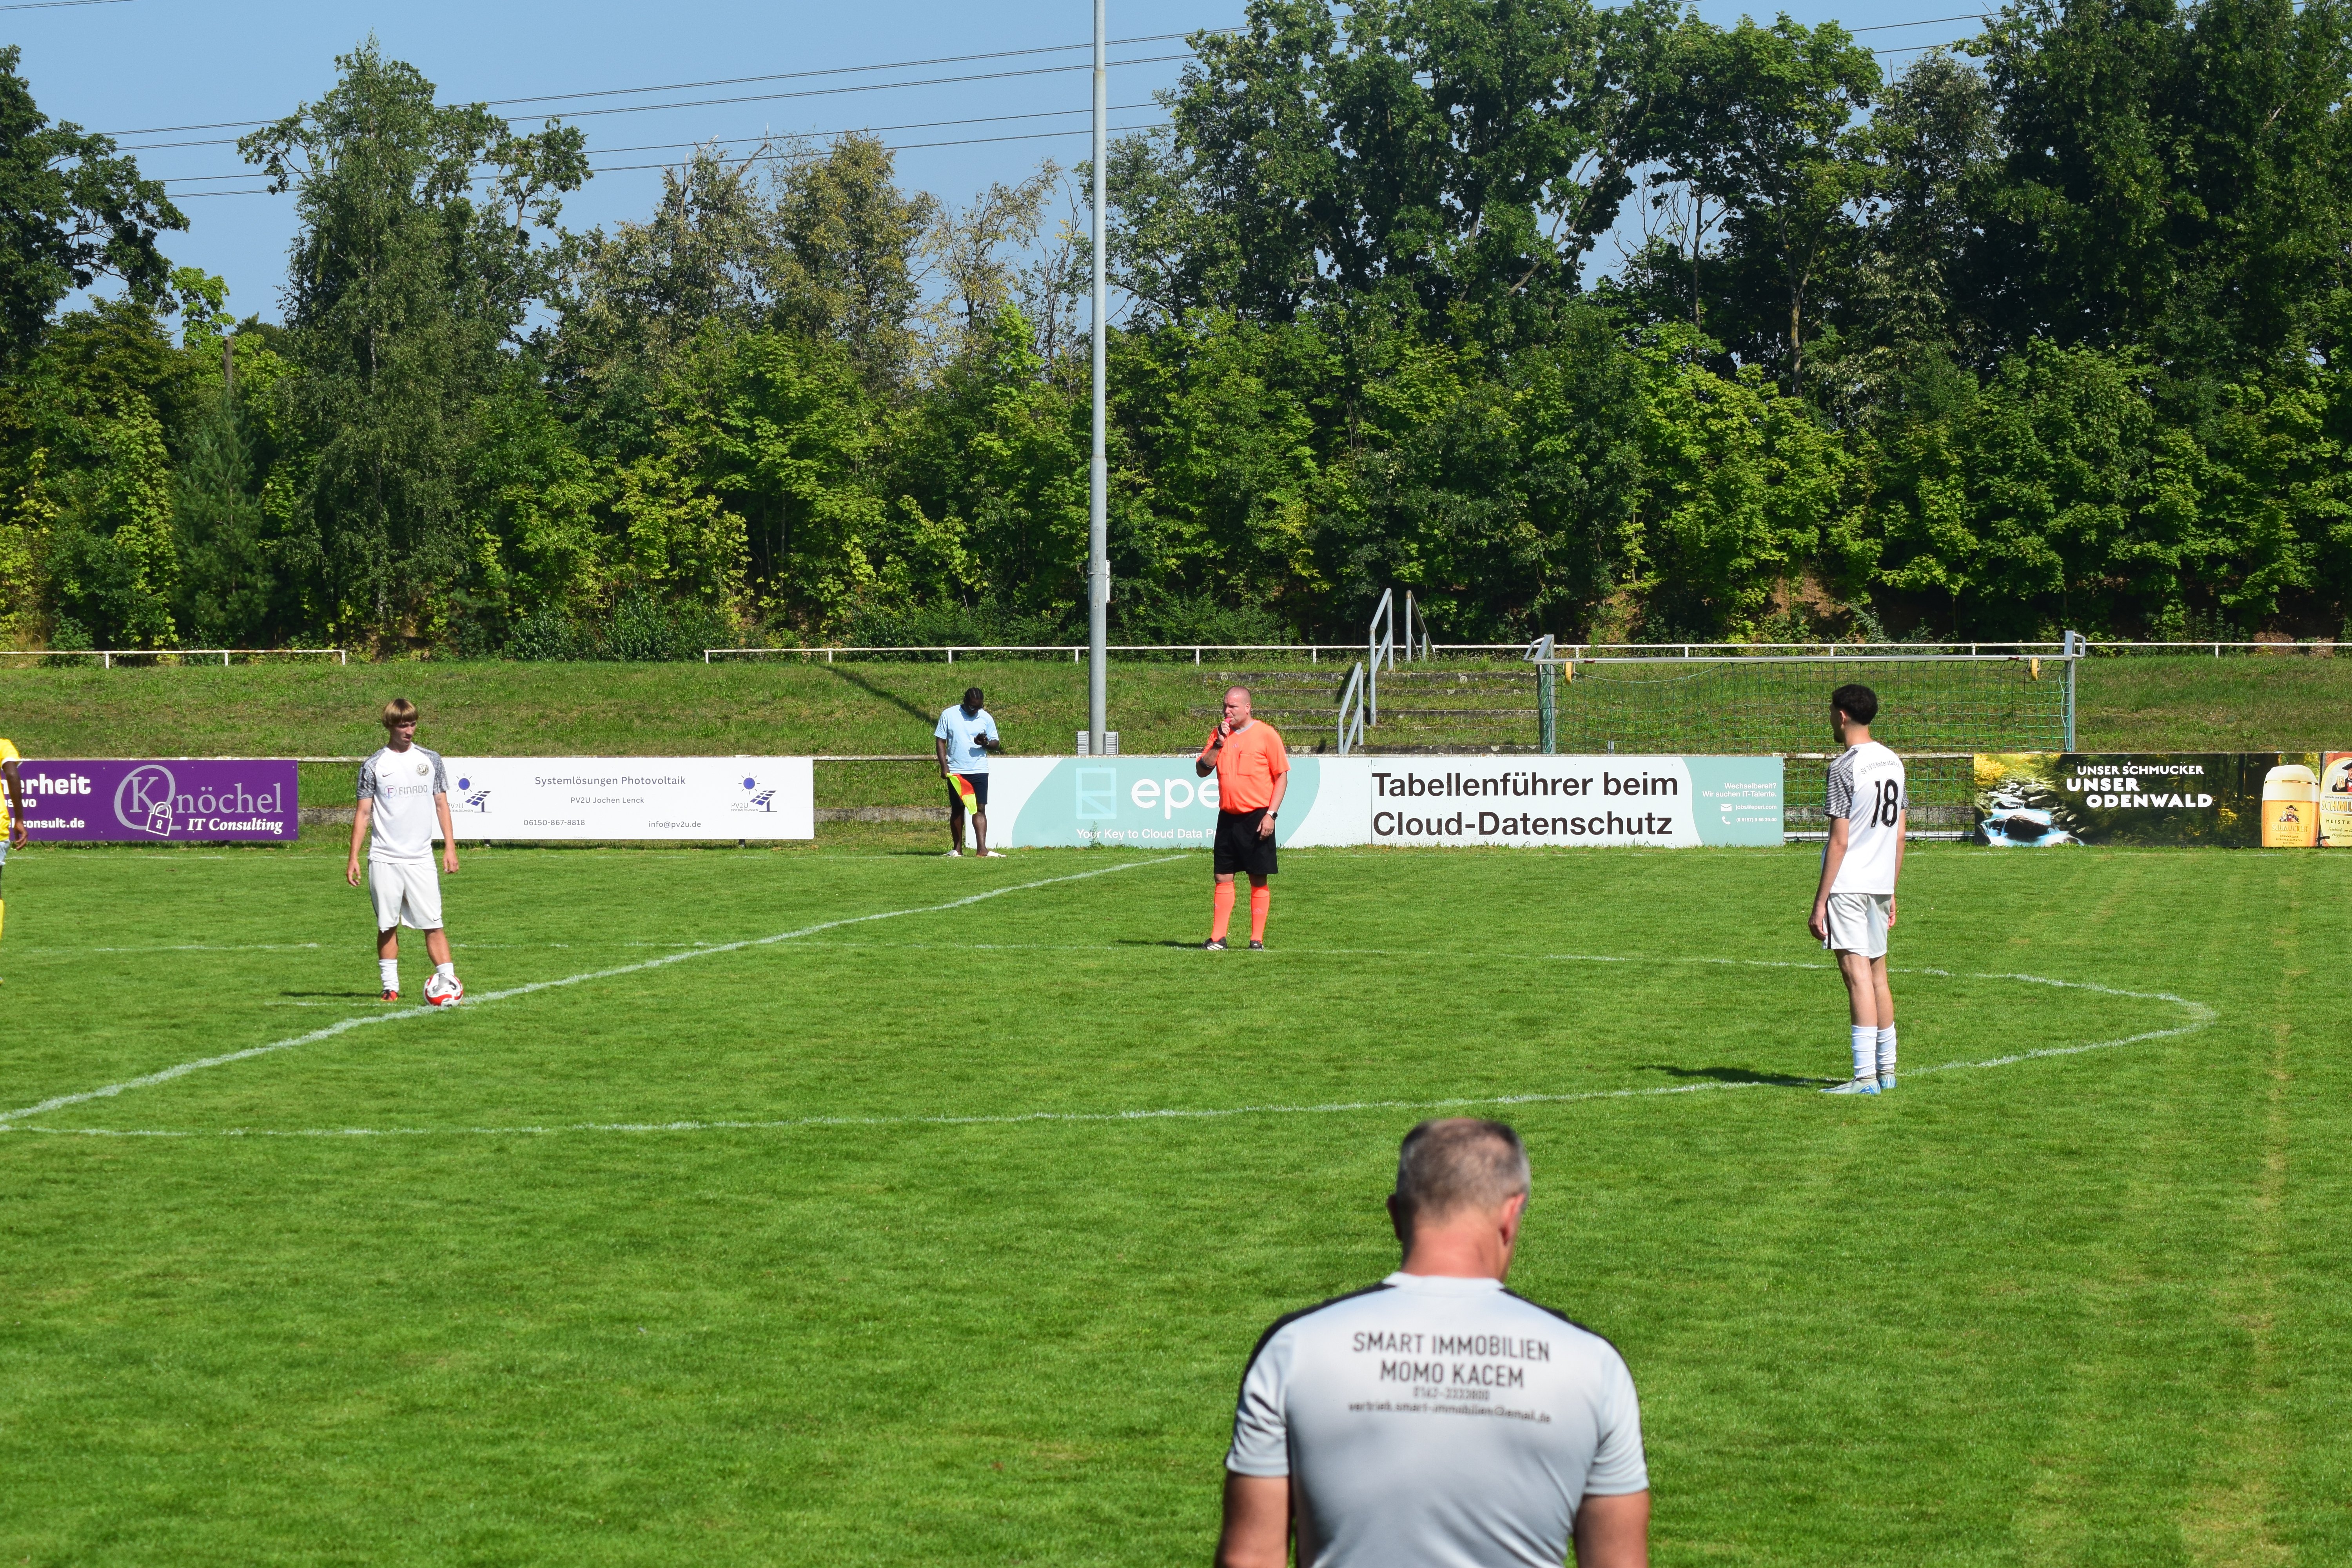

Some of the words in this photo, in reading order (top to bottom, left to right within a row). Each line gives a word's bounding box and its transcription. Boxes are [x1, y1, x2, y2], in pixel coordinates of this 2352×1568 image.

[2077, 766, 2120, 775] UNSER
[2122, 766, 2204, 775] SCHMUCKER
[535, 776, 618, 787] Systemlösungen
[621, 776, 686, 785] Photovoltaik
[1372, 772, 1593, 796] Tabellenführer
[1604, 772, 1678, 796] beim
[2067, 778, 2140, 791] UNSER
[129, 777, 283, 813] Knöchel
[399, 785, 428, 795] FINADO
[1870, 779, 1899, 829] 18
[2086, 794, 2212, 808] ODENWALD
[187, 818, 206, 831] IT
[209, 817, 283, 835] Consulting
[649, 821, 701, 829] info@pv2u.de
[1373, 811, 1673, 836] Cloud-Datenschutz
[1076, 829, 1101, 838] Your
[1104, 829, 1125, 840] Key
[1127, 829, 1138, 838] to
[1142, 829, 1174, 838] Cloud
[1178, 829, 1202, 838] Data
[1352, 1331, 1425, 1354] SMART
[1432, 1335, 1550, 1362] IMMOBILIEN
[1380, 1359, 1445, 1385] MOMO
[1452, 1363, 1524, 1389] KACEM
